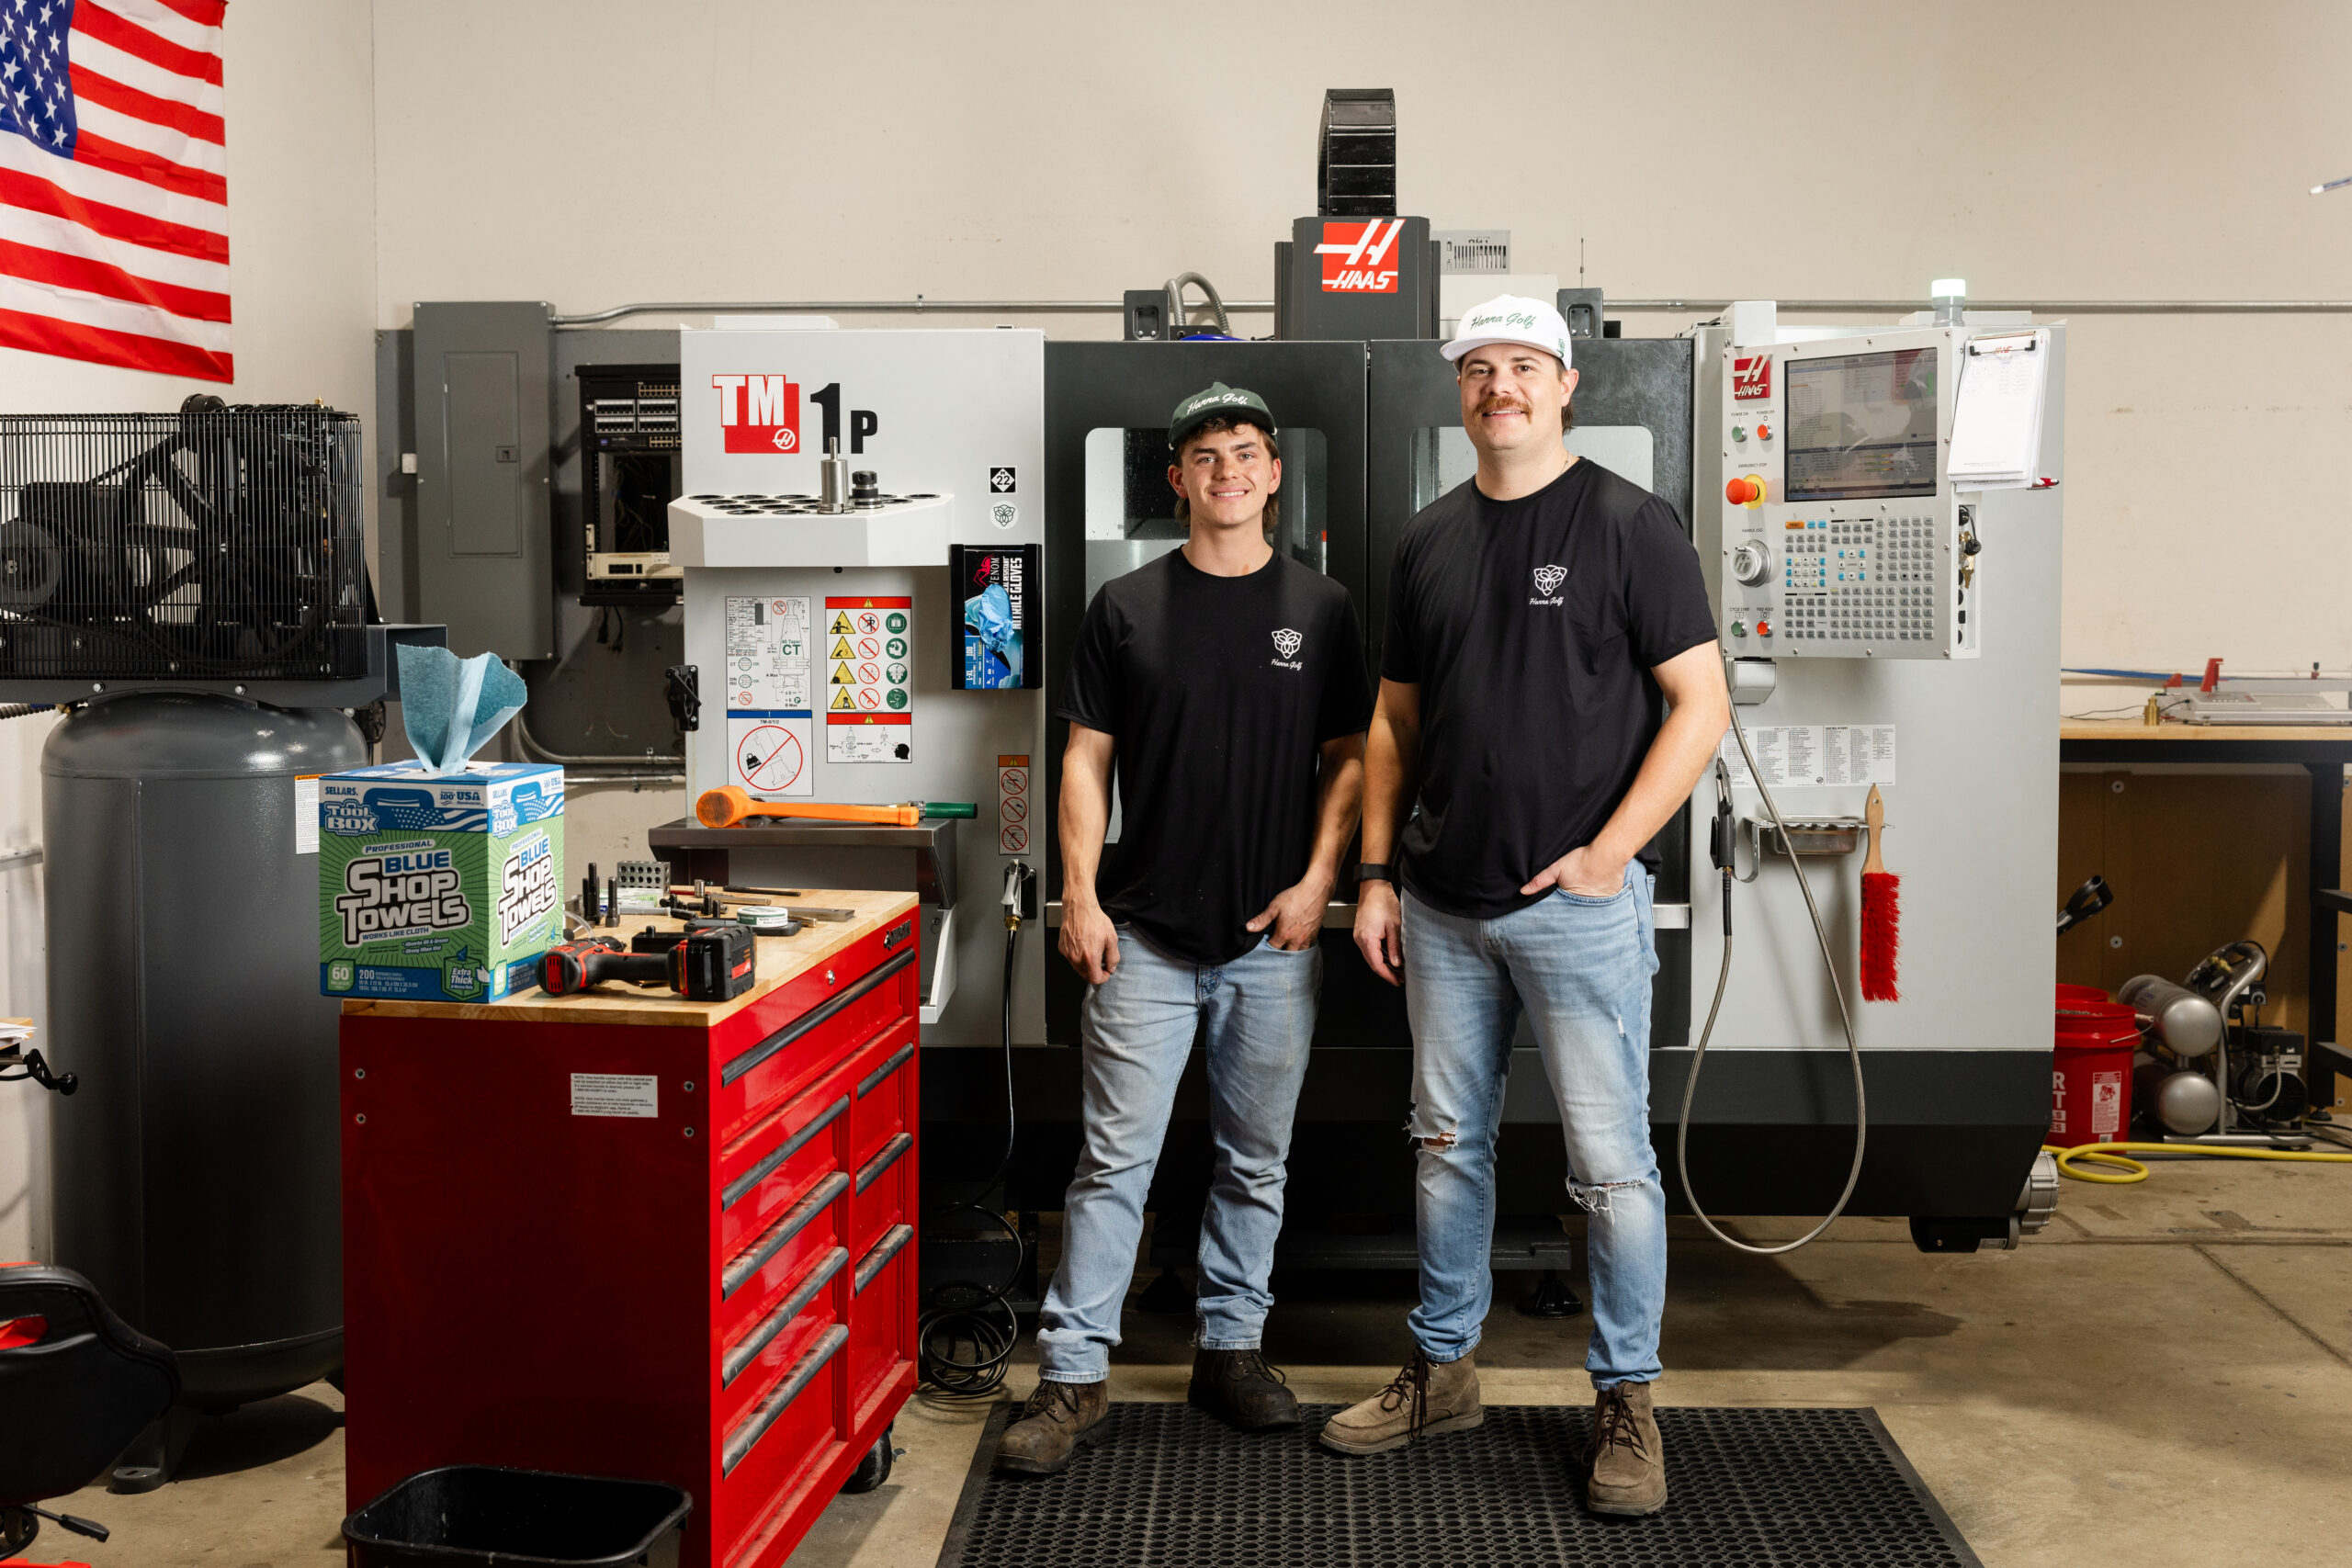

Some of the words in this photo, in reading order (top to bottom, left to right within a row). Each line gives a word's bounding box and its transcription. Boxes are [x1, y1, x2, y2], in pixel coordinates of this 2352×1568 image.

[1322, 270, 1398, 289] HAAS
[1470, 314, 1503, 331] Hanna
[1506, 313, 1536, 329] Golf
[1735, 384, 1767, 397] HAAS
[713, 375, 784, 426] TM
[1187, 395, 1220, 415] Hanna
[1222, 393, 1248, 405] Golf
[997, 476, 1010, 485] 22
[1011, 558, 1022, 593] GLOVES
[1012, 594, 1022, 629] NITRILE
[783, 644, 800, 655] CT
[457, 792, 481, 801] USA
[327, 804, 373, 817] TOOL
[328, 818, 377, 831] BOX
[494, 815, 518, 833] BOX
[366, 840, 432, 853] PROFESSIONAL
[521, 838, 548, 867] BLUE
[385, 851, 449, 874] BLUE
[349, 860, 457, 907] SHOP
[504, 855, 551, 904] SHOP
[339, 897, 467, 942] TOWELS
[500, 878, 555, 944] TOWELS
[362, 932, 388, 941] WORKS
[406, 927, 429, 935] CLOTH
[359, 970, 375, 979] 200
[451, 976, 474, 985] Thick
[452, 967, 471, 976] Extra
